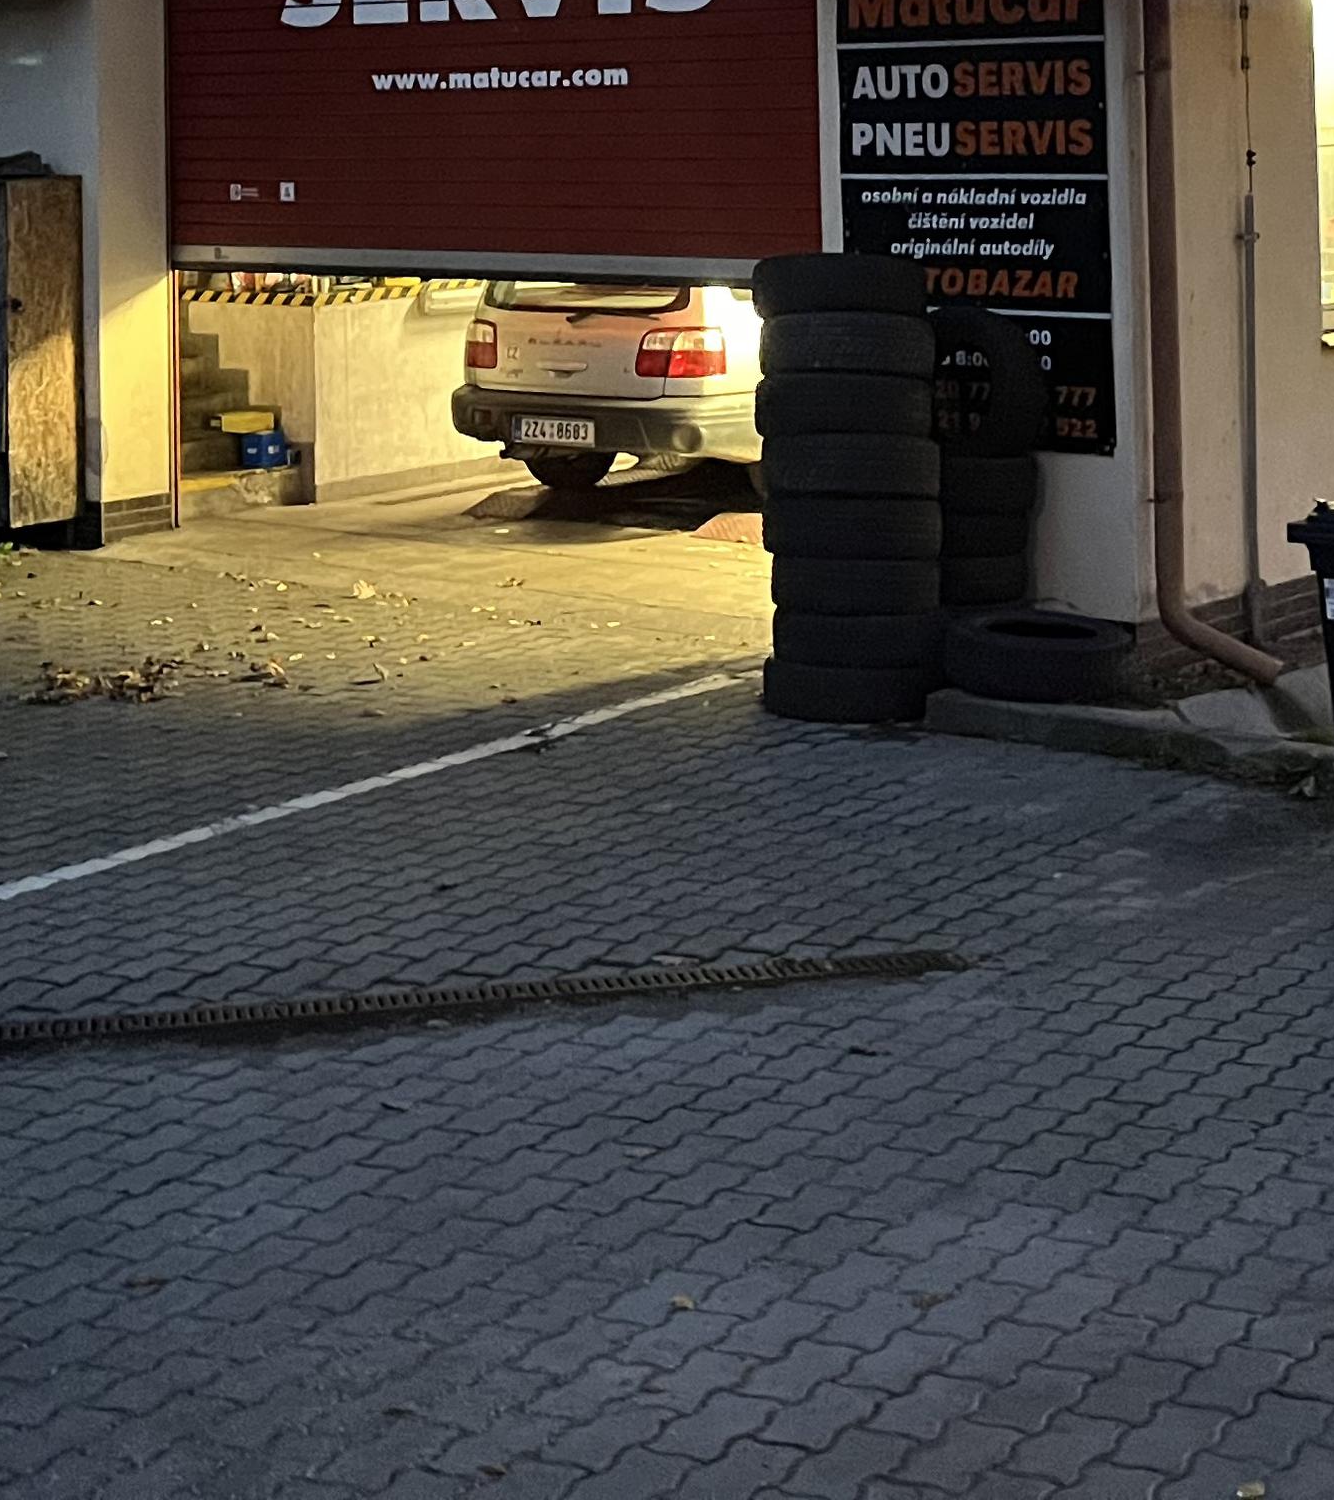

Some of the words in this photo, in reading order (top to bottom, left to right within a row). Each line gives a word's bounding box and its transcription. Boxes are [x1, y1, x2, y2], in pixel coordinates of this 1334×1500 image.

[371, 66, 629, 90] www.matucar.com
[861, 187, 919, 205] osobní
[921, 191, 932, 205] a
[936, 187, 1016, 206] nákladní
[1020, 188, 1087, 206] vozidla
[969, 212, 1035, 231] vozidel
[890, 238, 976, 260] originální
[979, 240, 1055, 260] autodíly
[923, 266, 1079, 299] TOBAZAR
